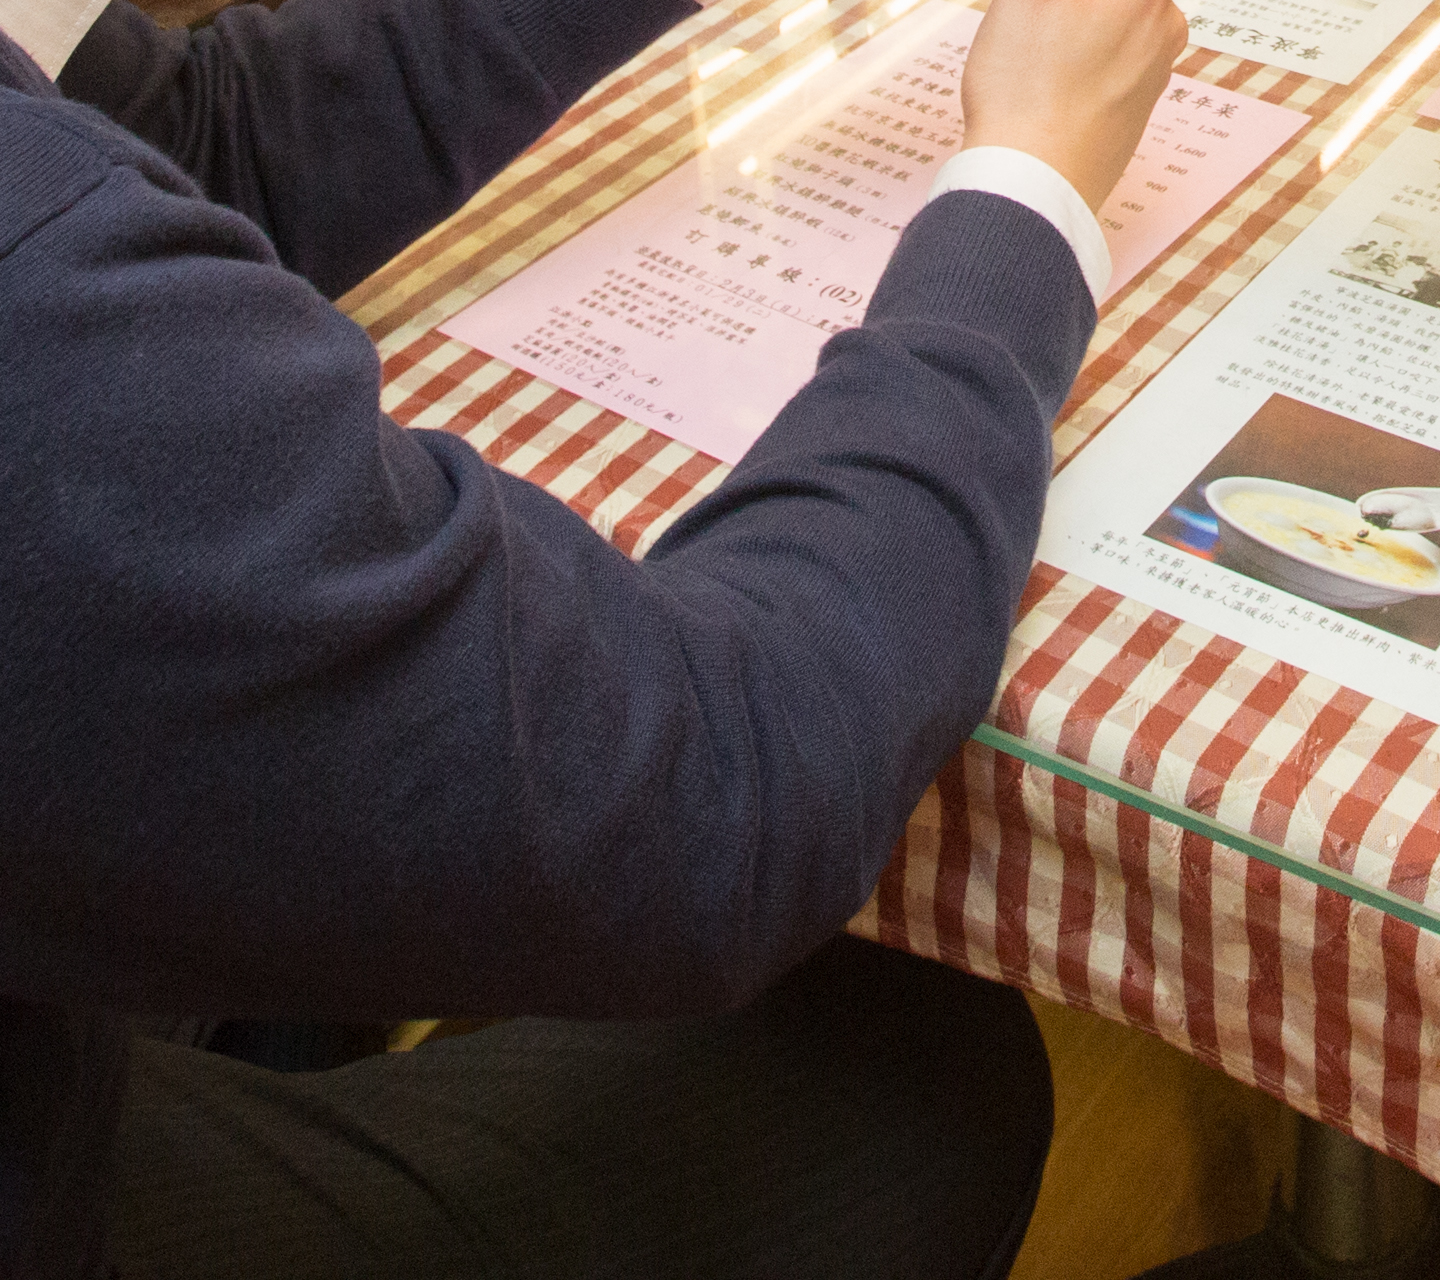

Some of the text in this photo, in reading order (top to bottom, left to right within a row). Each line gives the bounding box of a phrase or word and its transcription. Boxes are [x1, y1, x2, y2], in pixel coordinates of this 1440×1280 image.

[1159, 86, 1249, 121] 製年菜
[1193, 123, 1233, 139] 1,200
[791, 133, 918, 183] XO醬櫻花蝦米糕
[1169, 142, 1211, 159] 1,600
[768, 150, 859, 187] 紅燒獅子頭
[1160, 163, 1191, 176] 800
[1140, 179, 1172, 193] 900
[718, 184, 829, 230] 紹興冰鎮醉蝦
[1116, 199, 1149, 213] 680
[1095, 217, 1127, 231] 750
[1212, 374, 1254, 392] 甜品。
